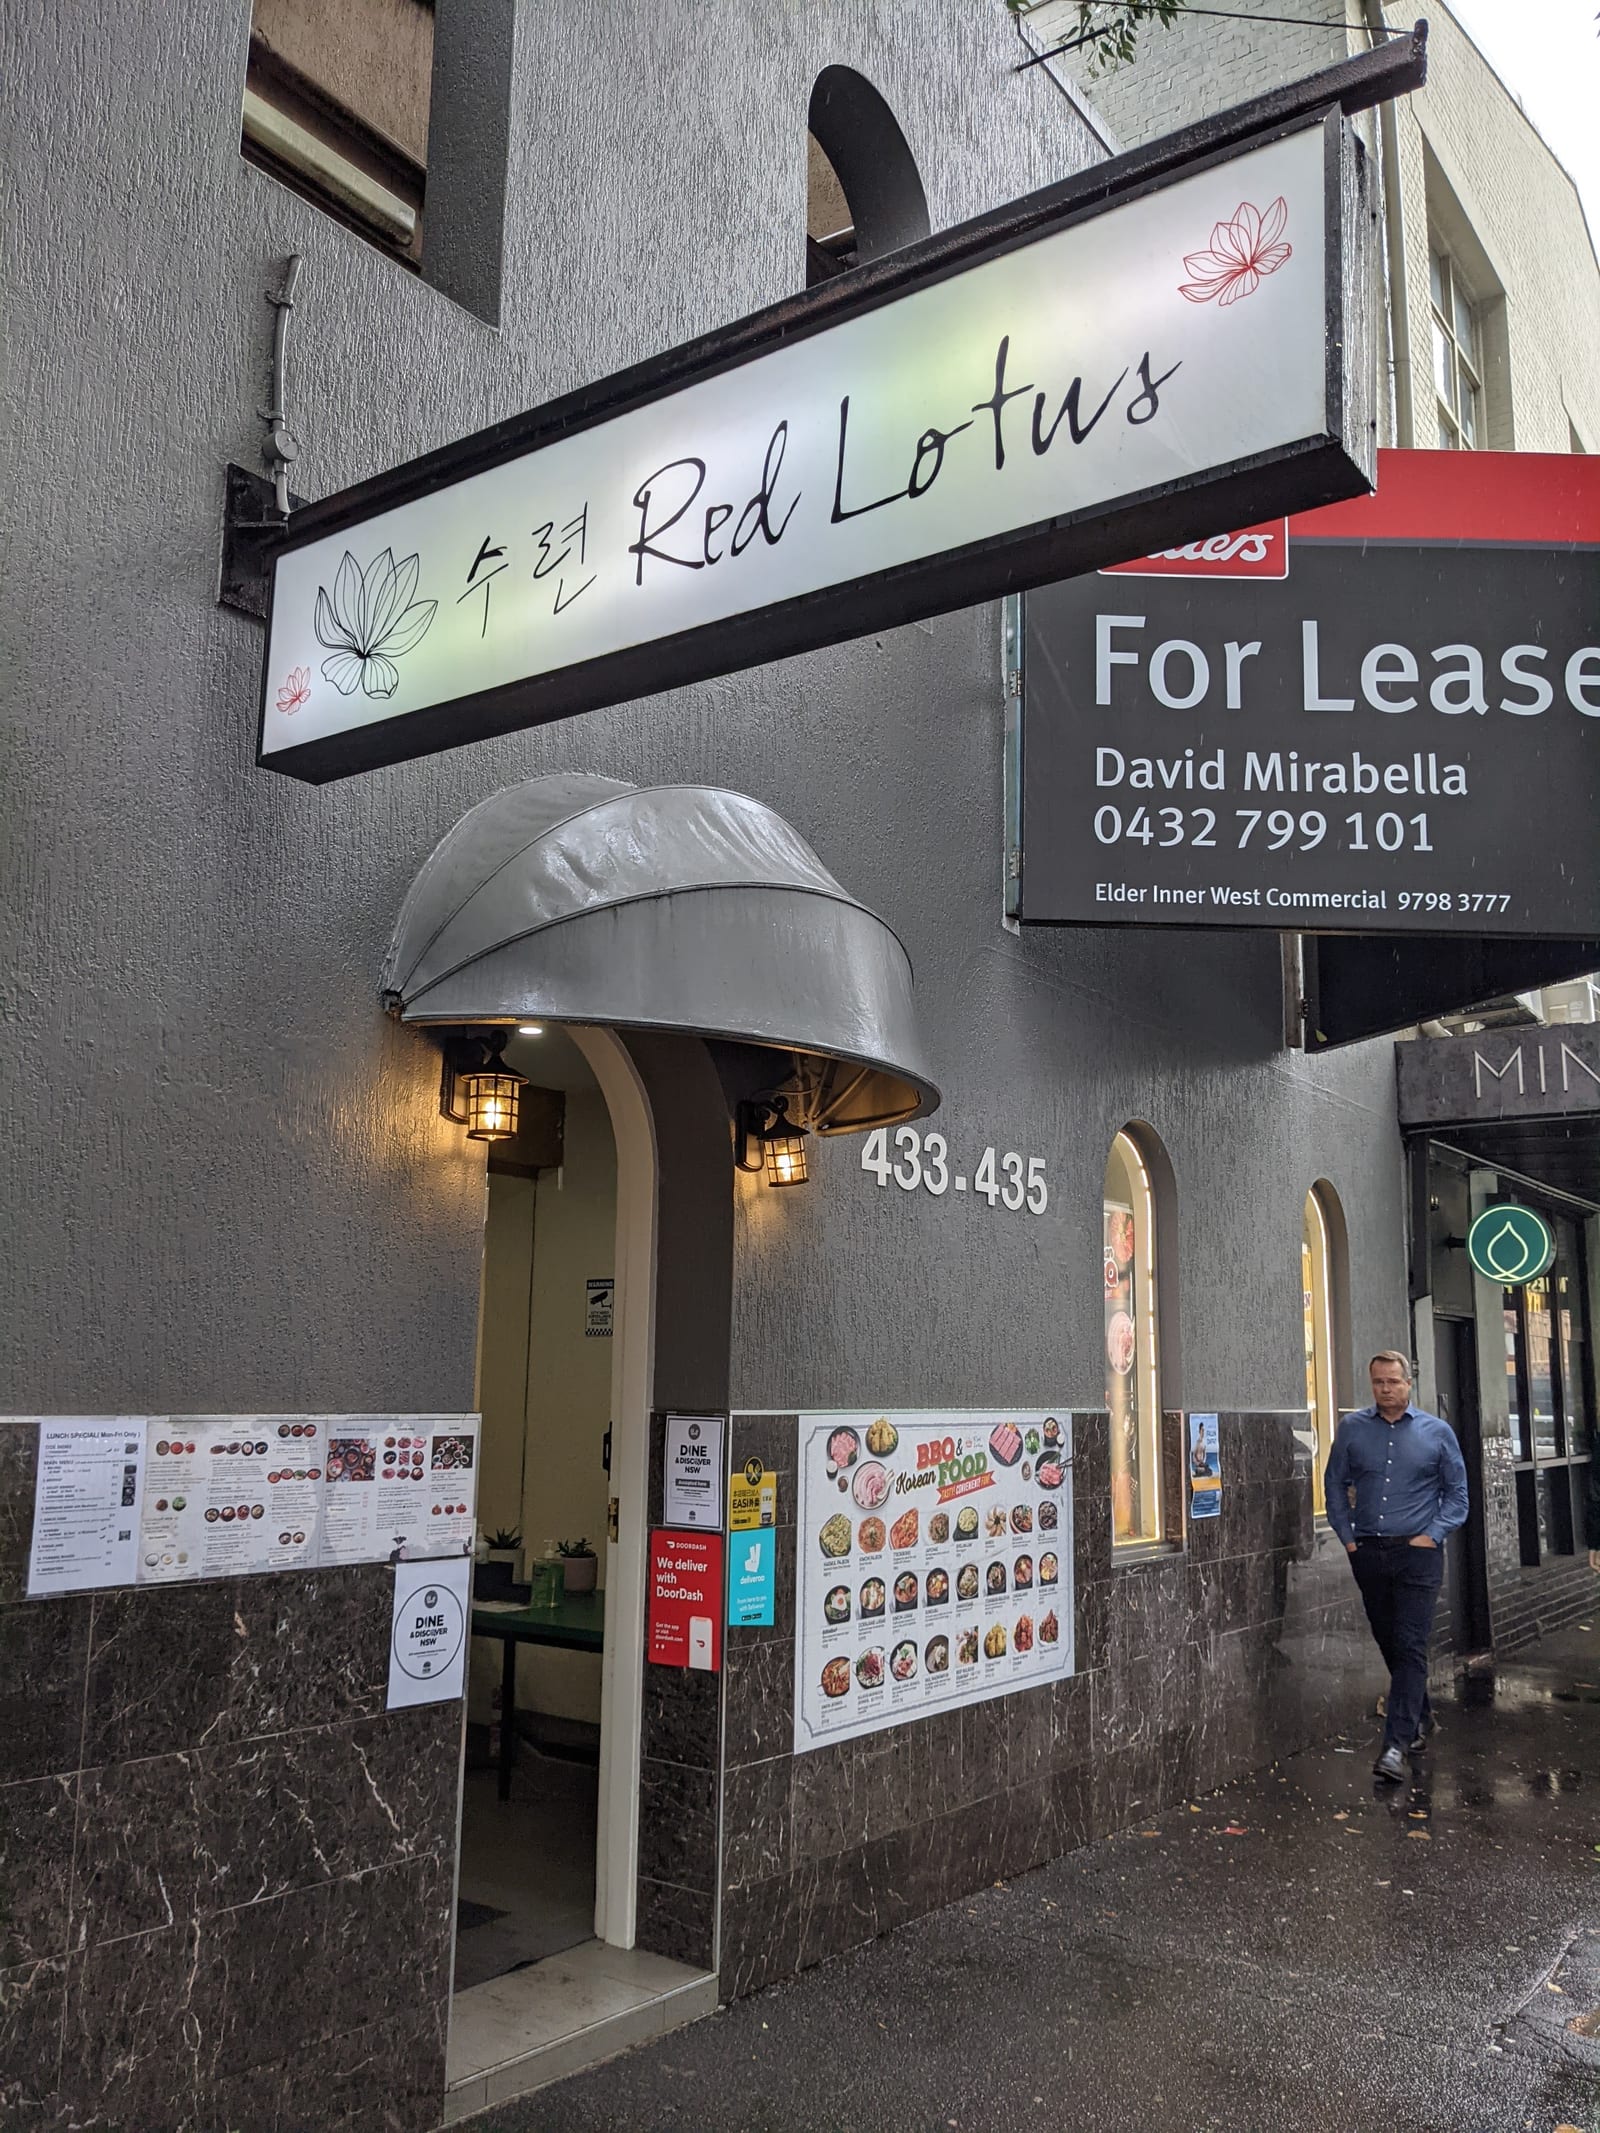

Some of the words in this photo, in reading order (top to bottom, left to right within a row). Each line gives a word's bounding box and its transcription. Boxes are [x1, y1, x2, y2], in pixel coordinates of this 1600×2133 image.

[628, 419, 801, 586] Red
[830, 334, 1183, 524] Lotus
[455, 500, 597, 639] 수련
[1095, 614, 1263, 711] For
[1301, 619, 1600, 719] Lease
[1095, 746, 1226, 791] David
[1243, 750, 1469, 797] Mirabella
[1093, 804, 1217, 848] 0432
[1235, 809, 1328, 852] 799
[1345, 811, 1434, 852] 101
[1095, 882, 1148, 903] Elder
[1153, 884, 1206, 905] Inner
[1210, 886, 1262, 907] West
[1266, 888, 1388, 910] Commercial
[1397, 891, 1452, 911] 9798
[1457, 893, 1512, 913] 3777
[46, 1432, 69, 1440] LUNCH
[680, 1444, 708, 1457] DINE
[956, 1437, 963, 1456] &
[680, 1457, 711, 1466] DISCOVER
[684, 1466, 701, 1474] NSW
[895, 1468, 936, 1495] Korean
[938, 1451, 988, 1487] FOOD
[676, 1542, 707, 1550] DOORDASH
[656, 1556, 673, 1569] We
[675, 1558, 708, 1572] deliver
[656, 1572, 677, 1584] with
[740, 1575, 765, 1584] deliveroo
[656, 1585, 704, 1602] DoorDash
[416, 1615, 444, 1629] DINE
[415, 1628, 448, 1637] DISCOVER
[420, 1638, 437, 1646] NSW
